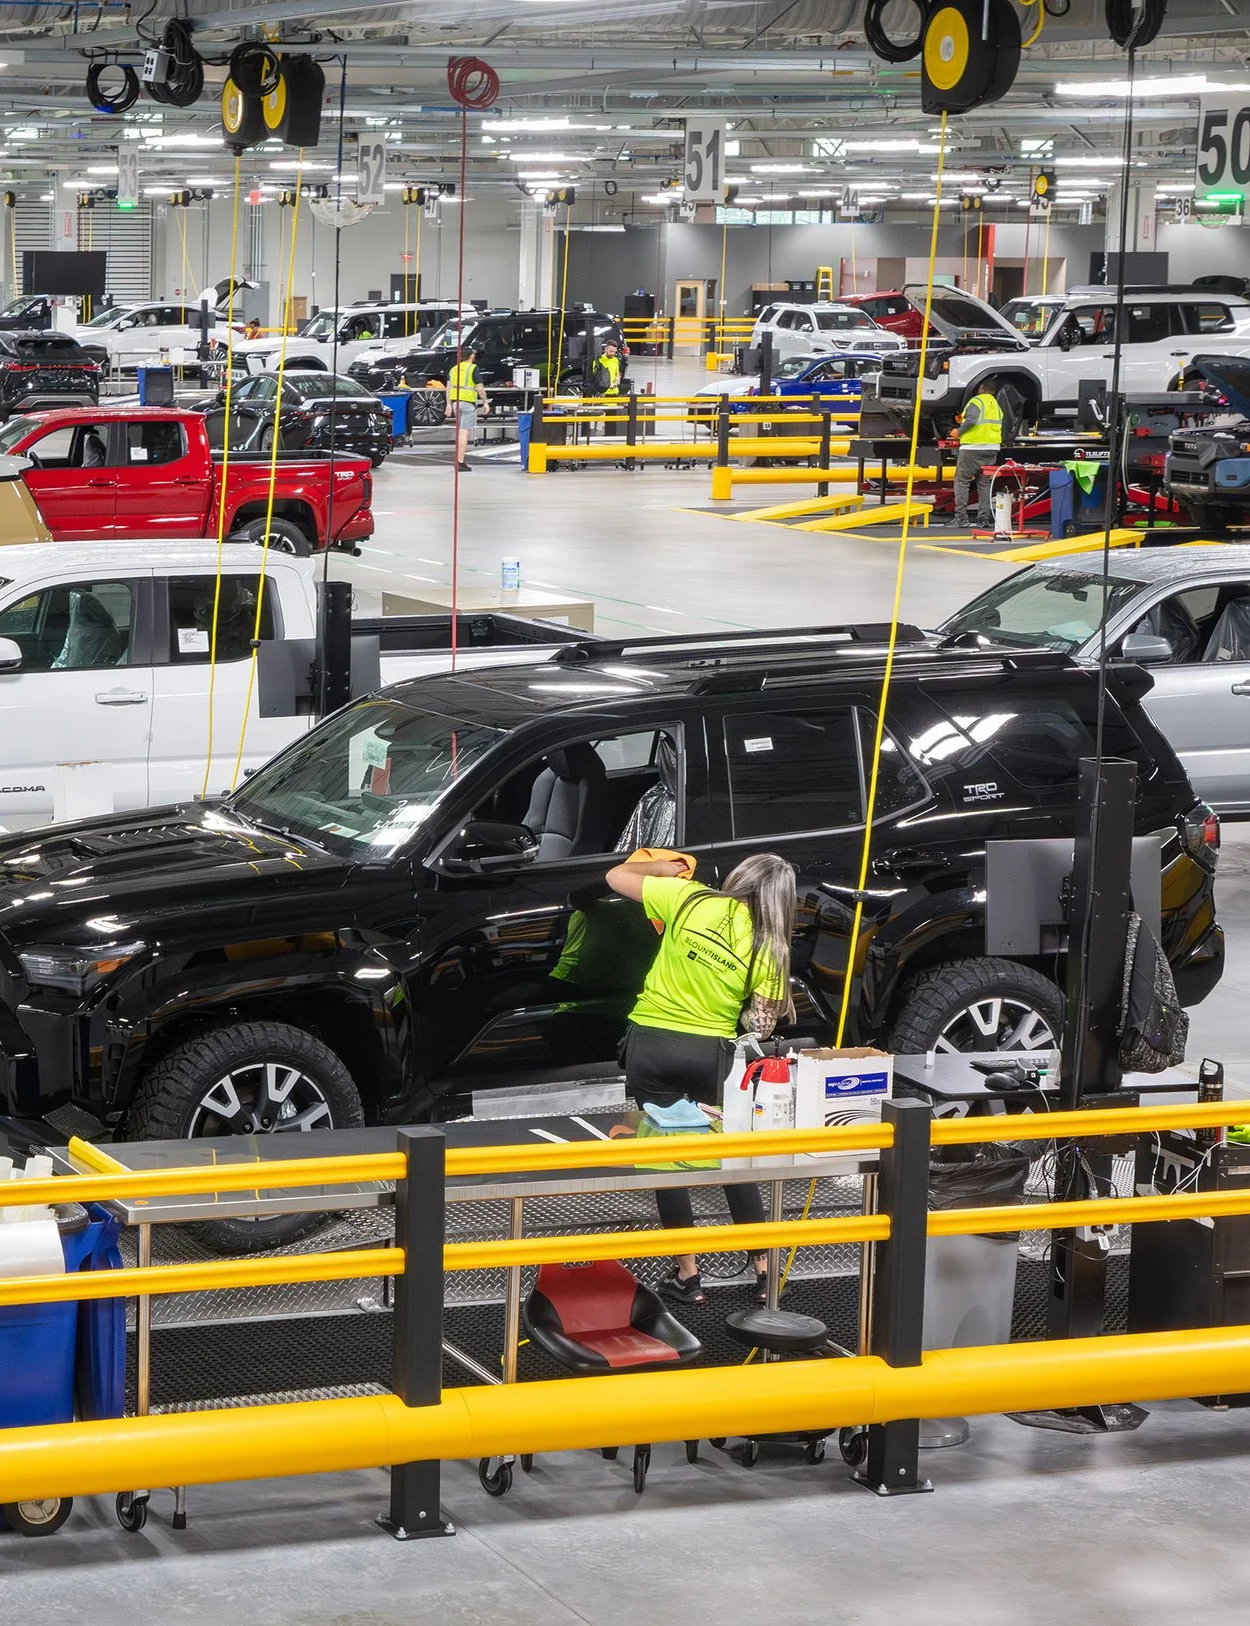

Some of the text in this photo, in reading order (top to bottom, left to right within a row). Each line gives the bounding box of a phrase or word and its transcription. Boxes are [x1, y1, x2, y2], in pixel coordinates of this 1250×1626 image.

[1198, 107, 1250, 186] 50
[358, 144, 385, 195] 52
[686, 130, 720, 191] 51
[843, 186, 859, 212] 44
[1176, 199, 1190, 216] 36
[963, 782, 998, 796] TRD
[963, 792, 1005, 802] SPORT
